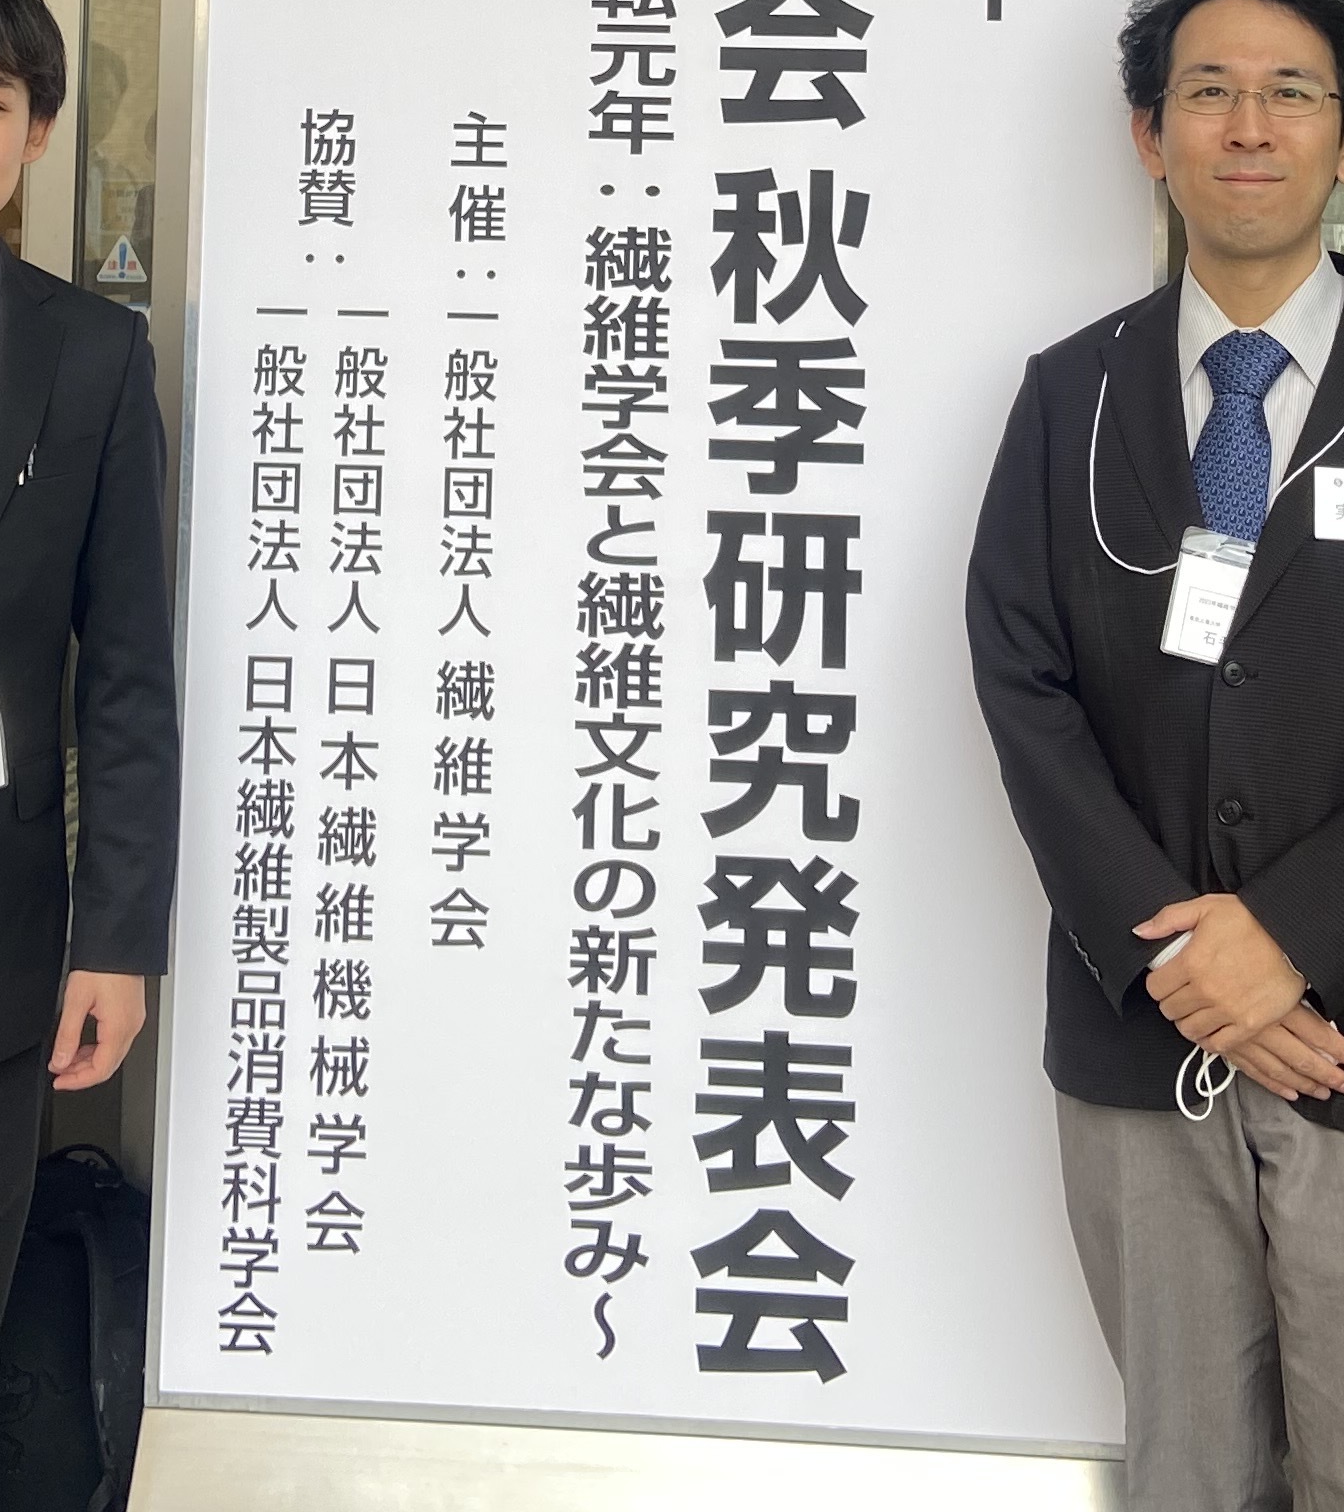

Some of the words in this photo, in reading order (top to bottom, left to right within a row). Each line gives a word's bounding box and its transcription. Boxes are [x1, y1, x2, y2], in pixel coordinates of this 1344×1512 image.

[689, 166, 871, 1386] 秋季研究発表会
